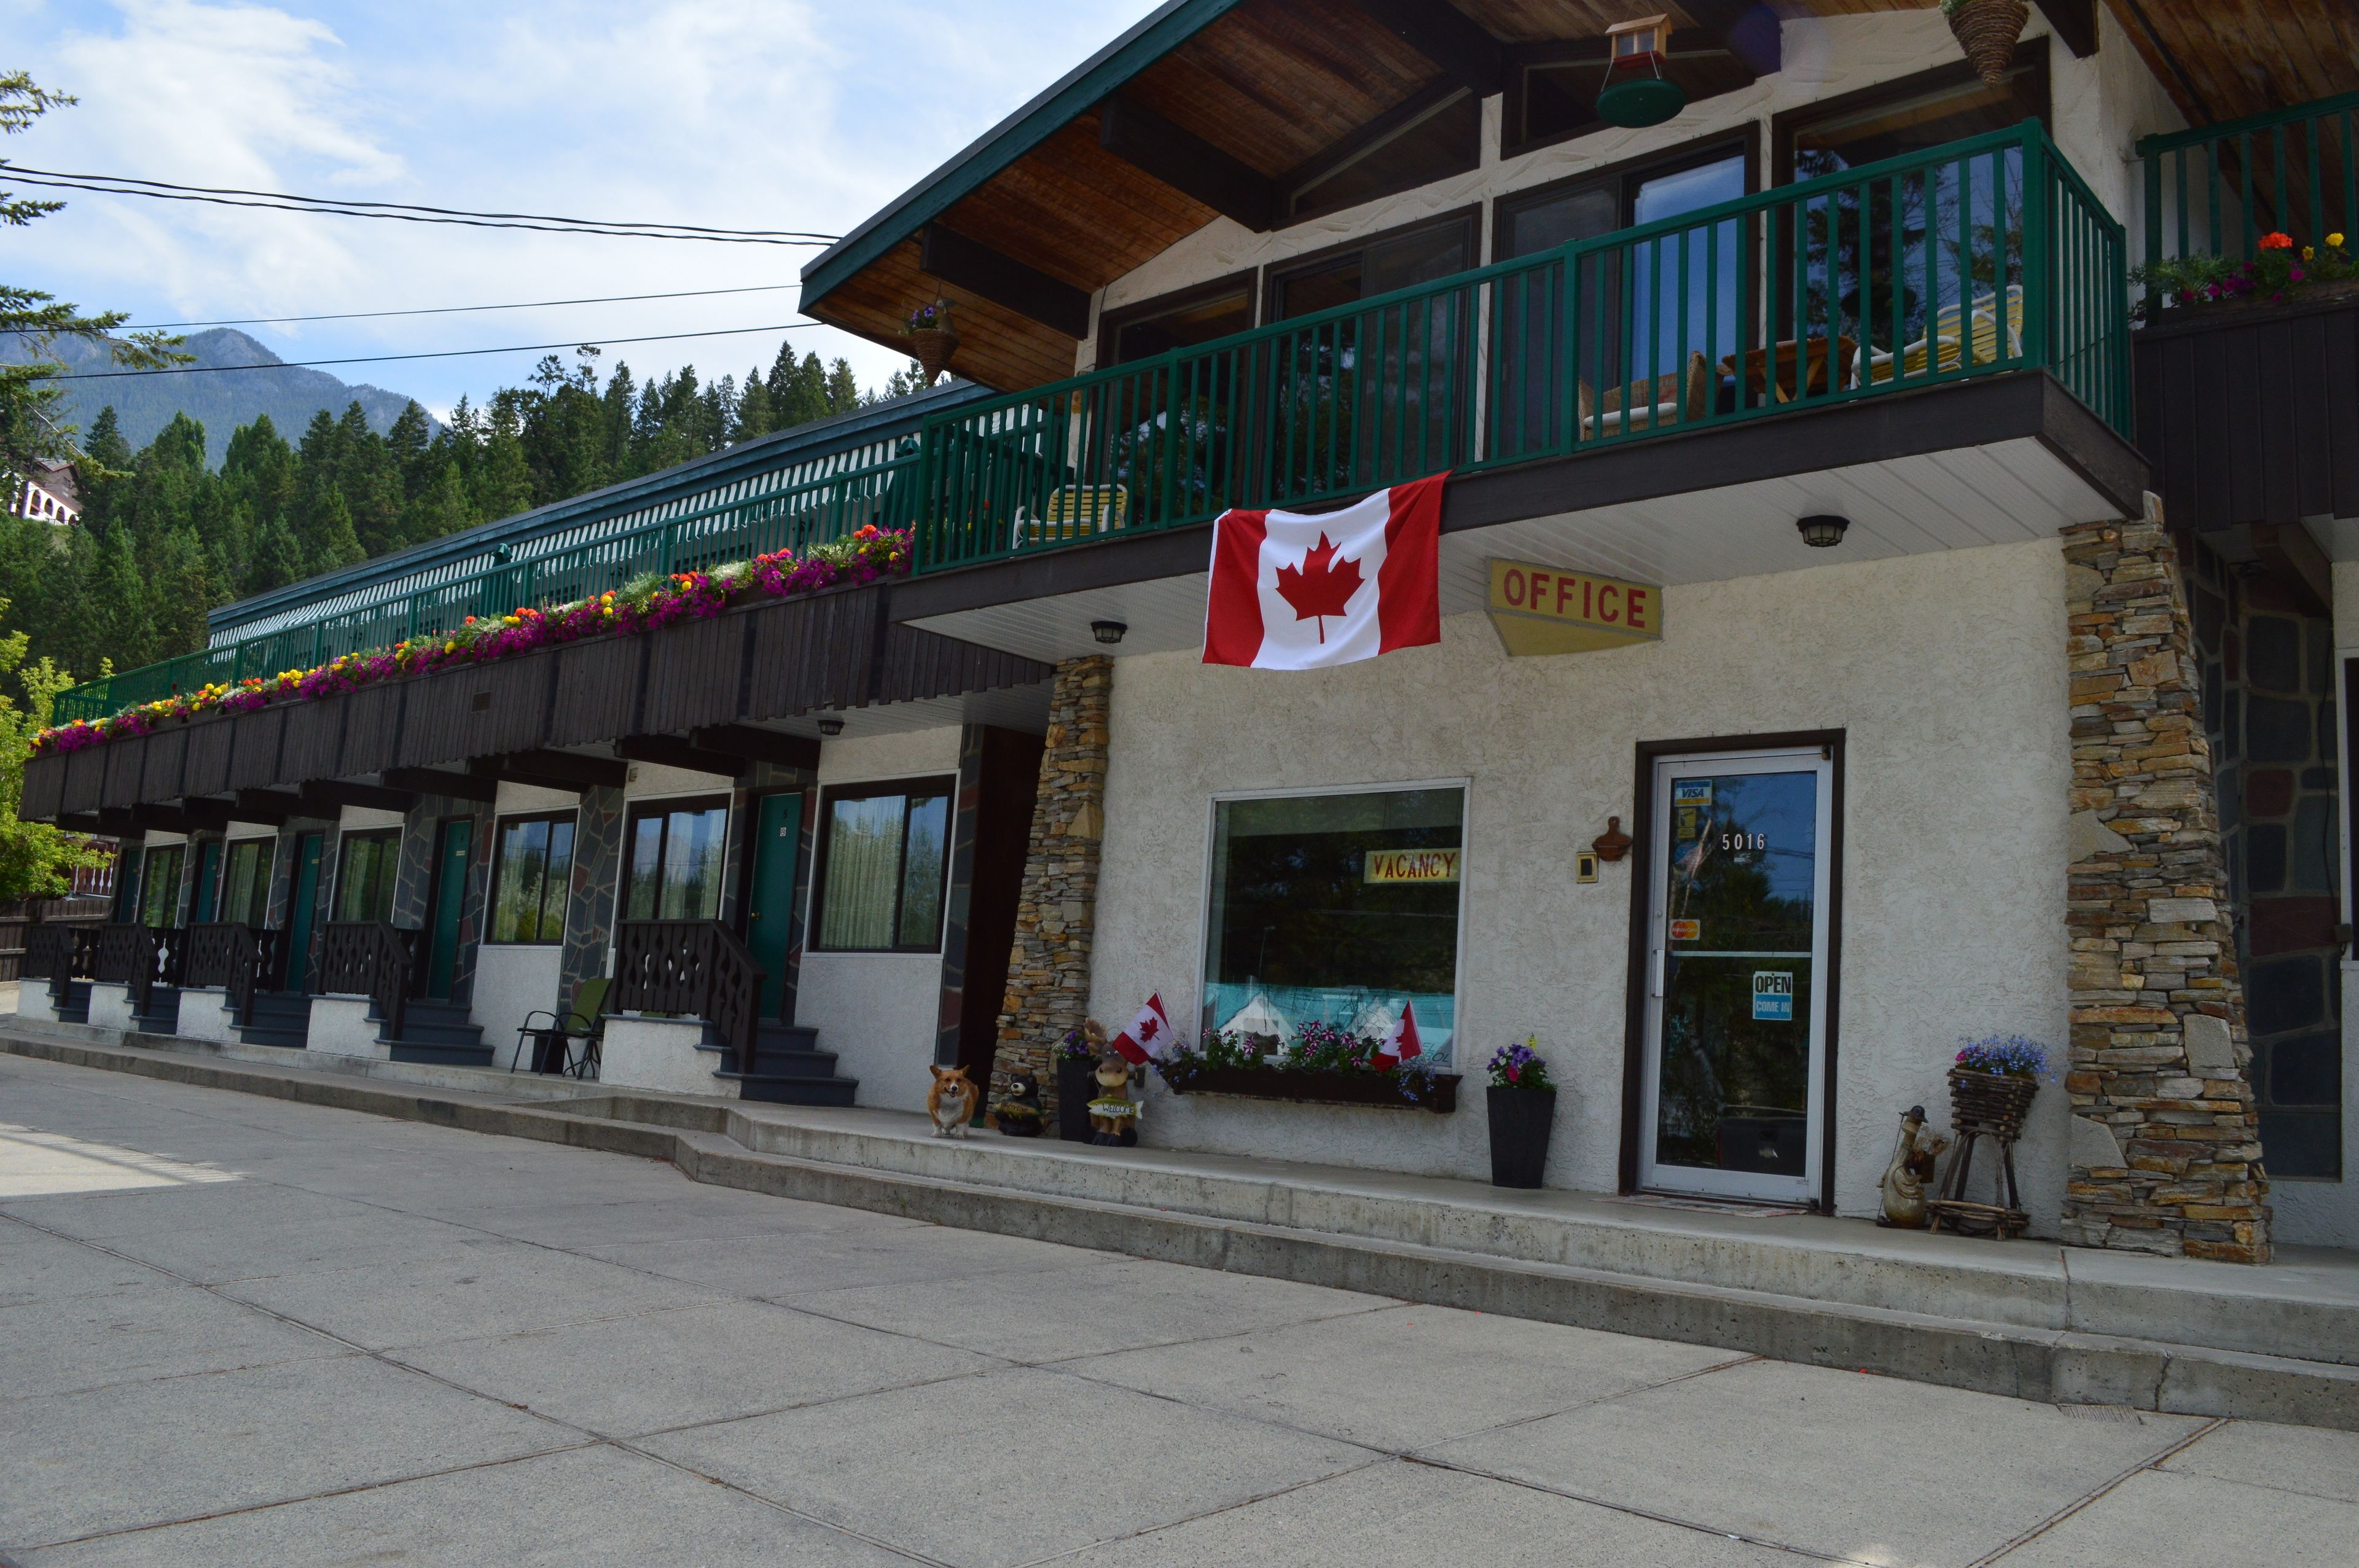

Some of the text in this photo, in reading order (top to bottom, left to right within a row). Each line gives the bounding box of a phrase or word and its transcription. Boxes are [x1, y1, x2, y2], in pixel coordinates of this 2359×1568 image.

[1503, 569, 1646, 628] OFFICE
[1681, 788, 1704, 798] VISA
[1722, 833, 1765, 850] 5016
[1374, 852, 1457, 878] VACANCY
[1755, 975, 1791, 993] OPEN
[1756, 1001, 1790, 1013] COME IN
[1102, 1103, 1133, 1114] WELCOME
